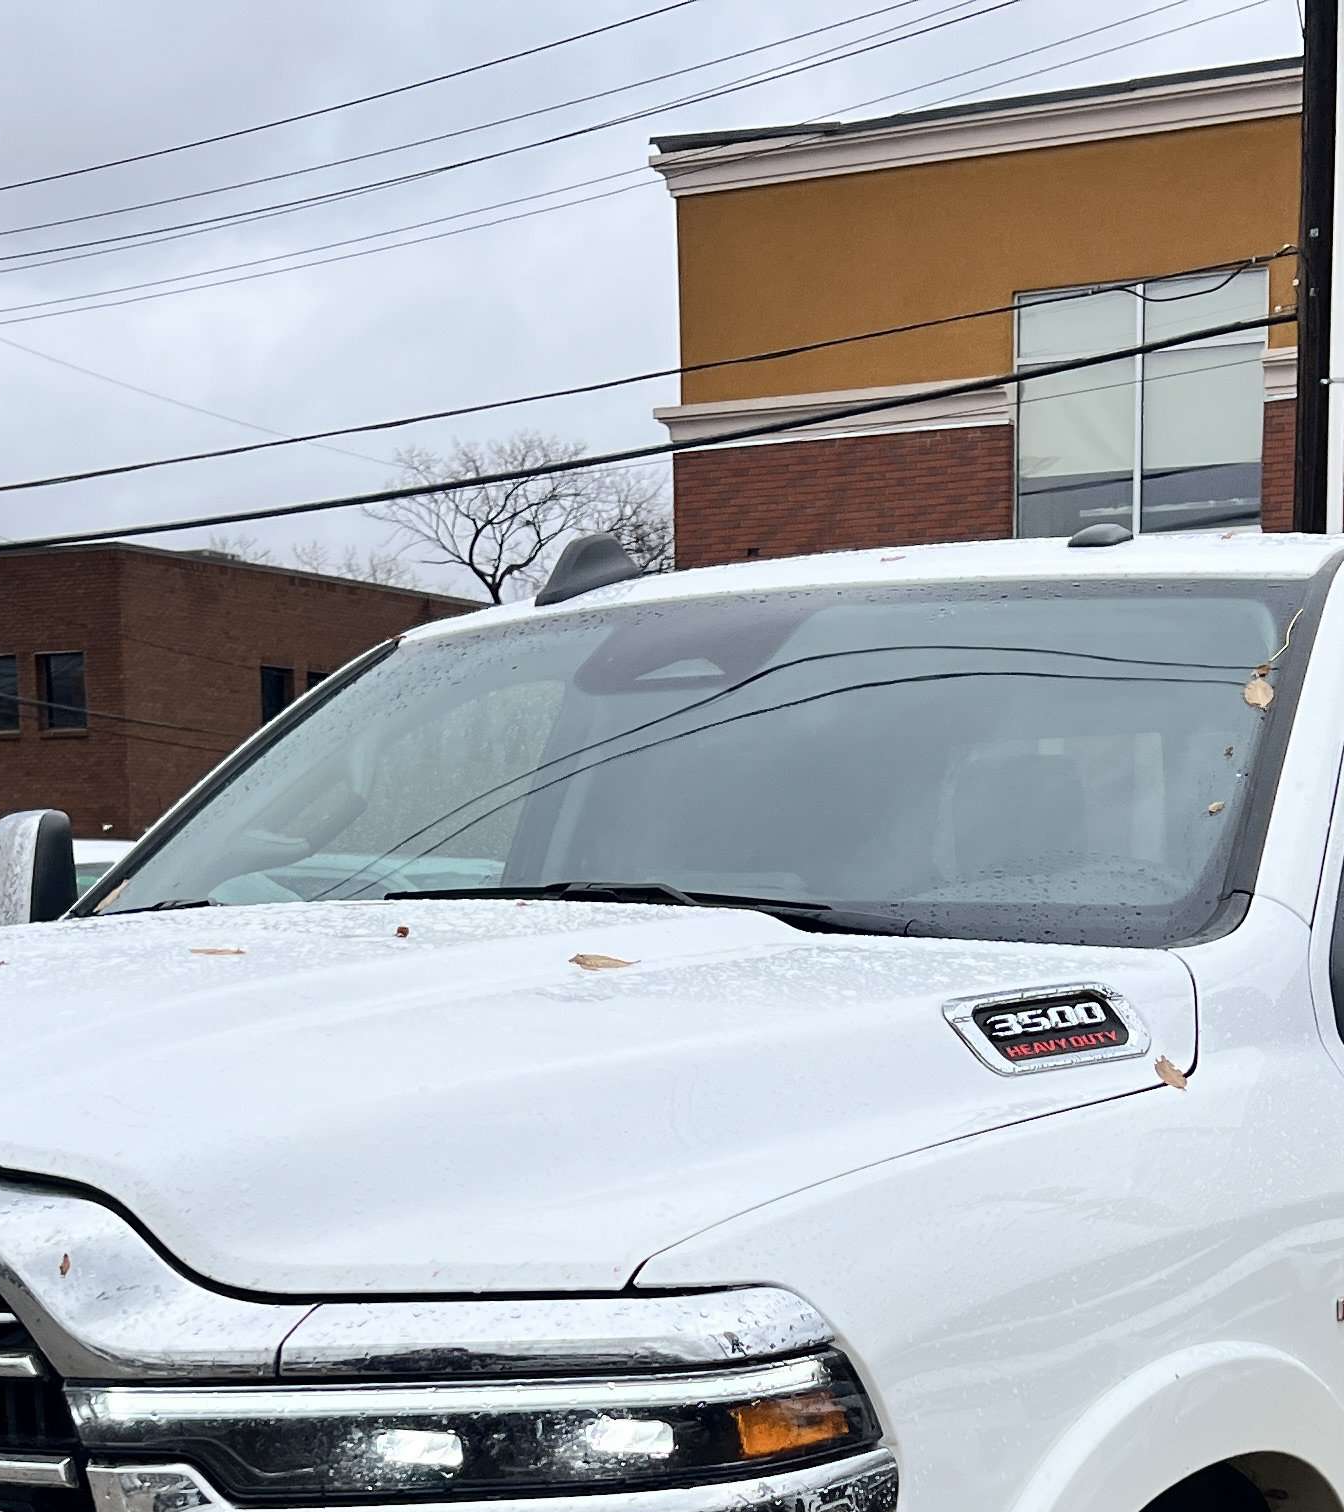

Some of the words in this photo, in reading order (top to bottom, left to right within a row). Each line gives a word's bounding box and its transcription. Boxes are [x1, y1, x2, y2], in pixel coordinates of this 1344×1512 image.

[986, 1001, 1107, 1036] 3500
[1006, 1038, 1067, 1058] HEAVY
[1069, 1030, 1118, 1048] DUTY
